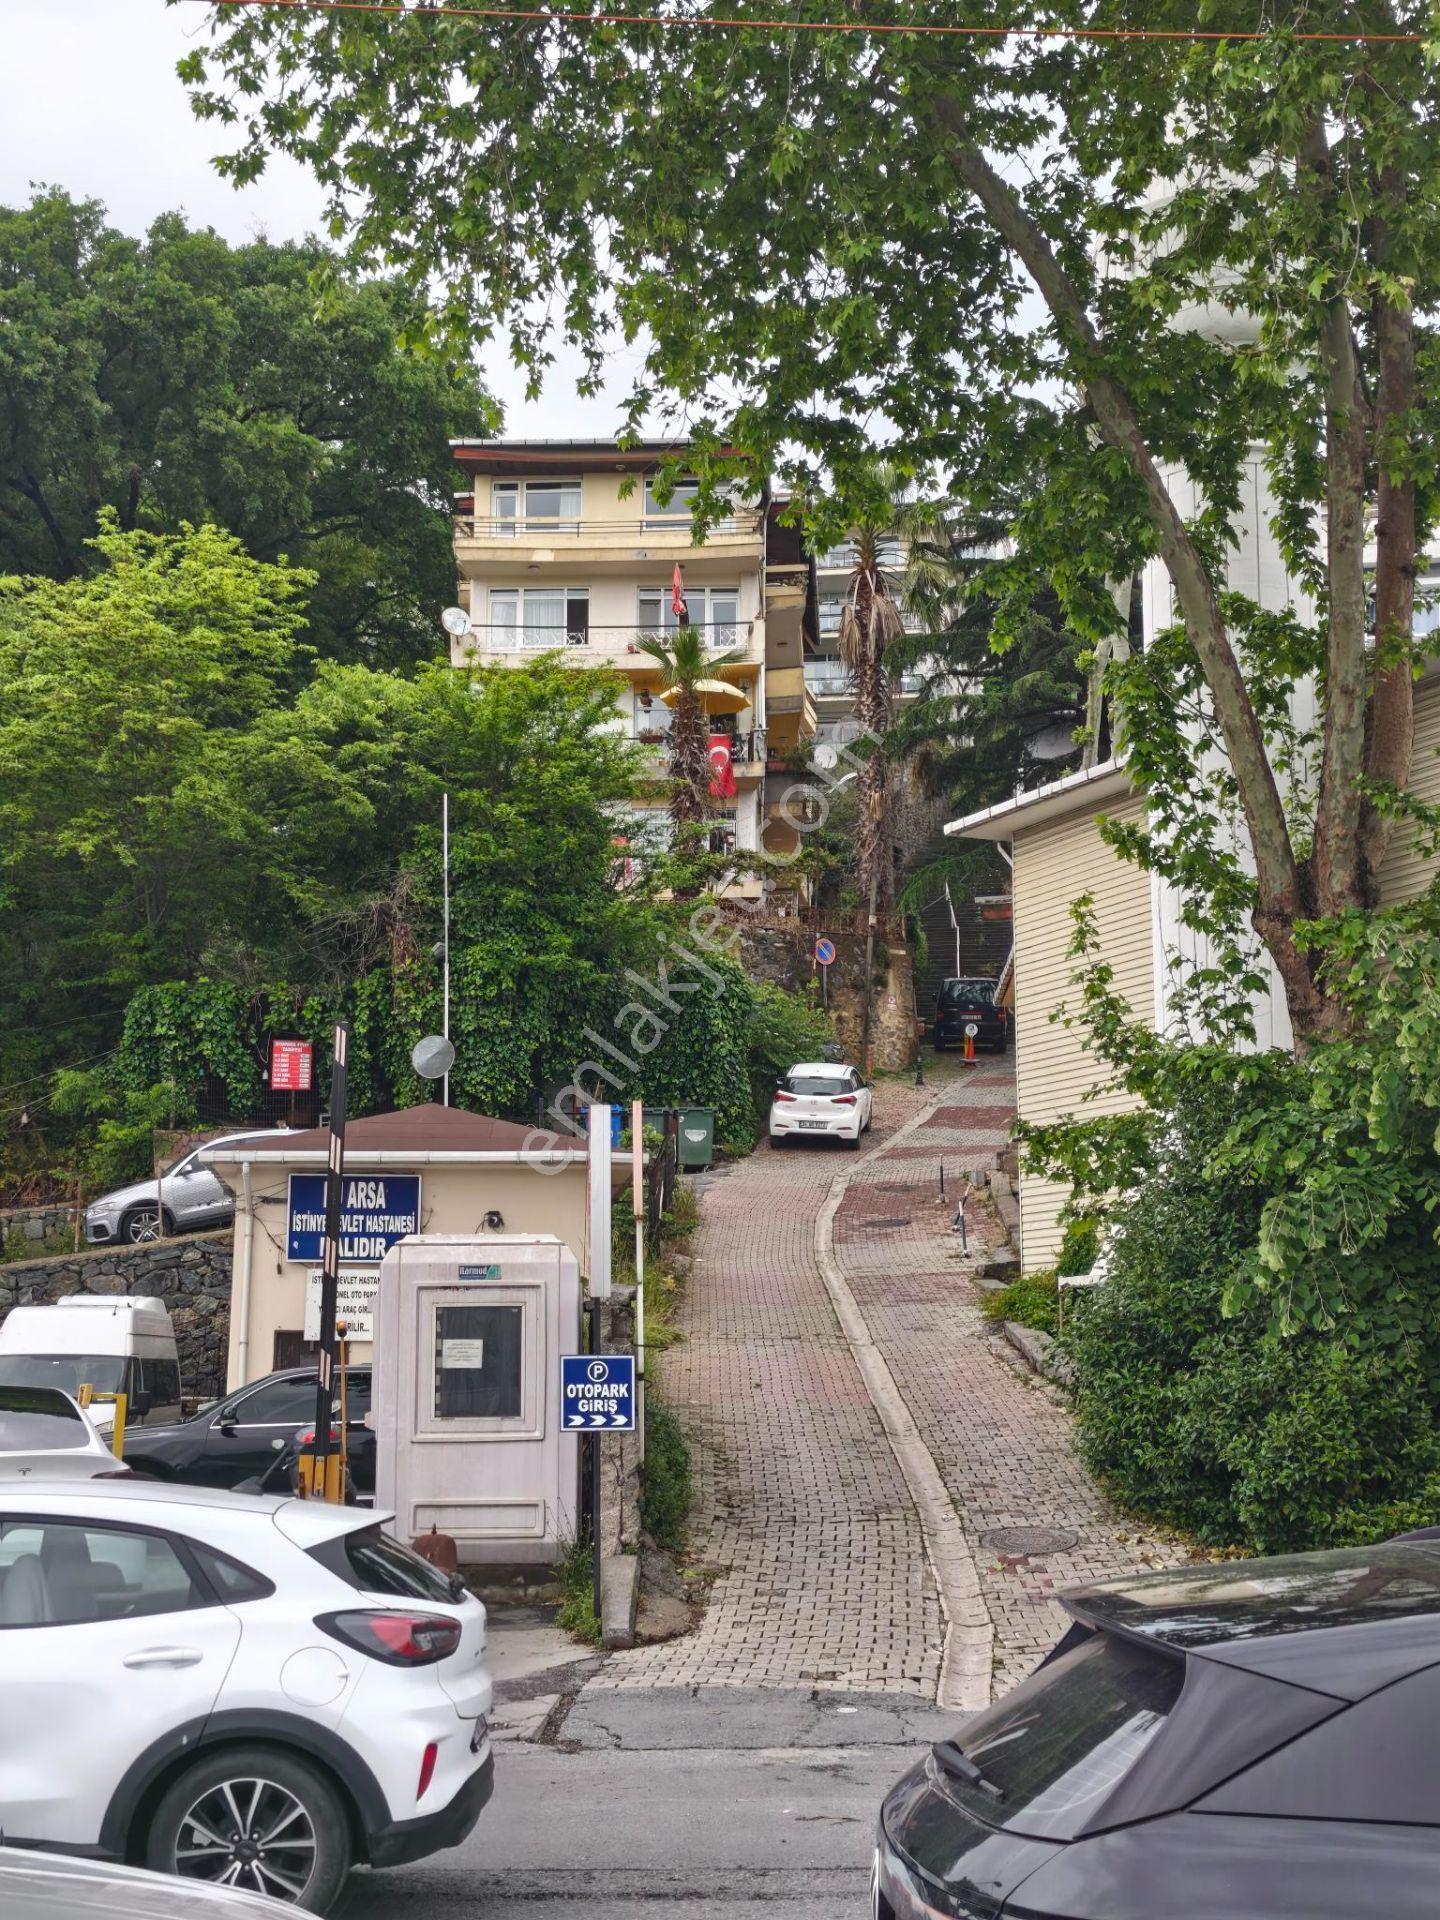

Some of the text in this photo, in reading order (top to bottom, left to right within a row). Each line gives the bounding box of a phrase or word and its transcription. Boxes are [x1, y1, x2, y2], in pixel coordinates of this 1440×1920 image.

[347, 1181, 386, 1208] ARSA
[366, 1211, 415, 1233] HASTANESİ
[567, 1384, 629, 1398] OTOPARK
